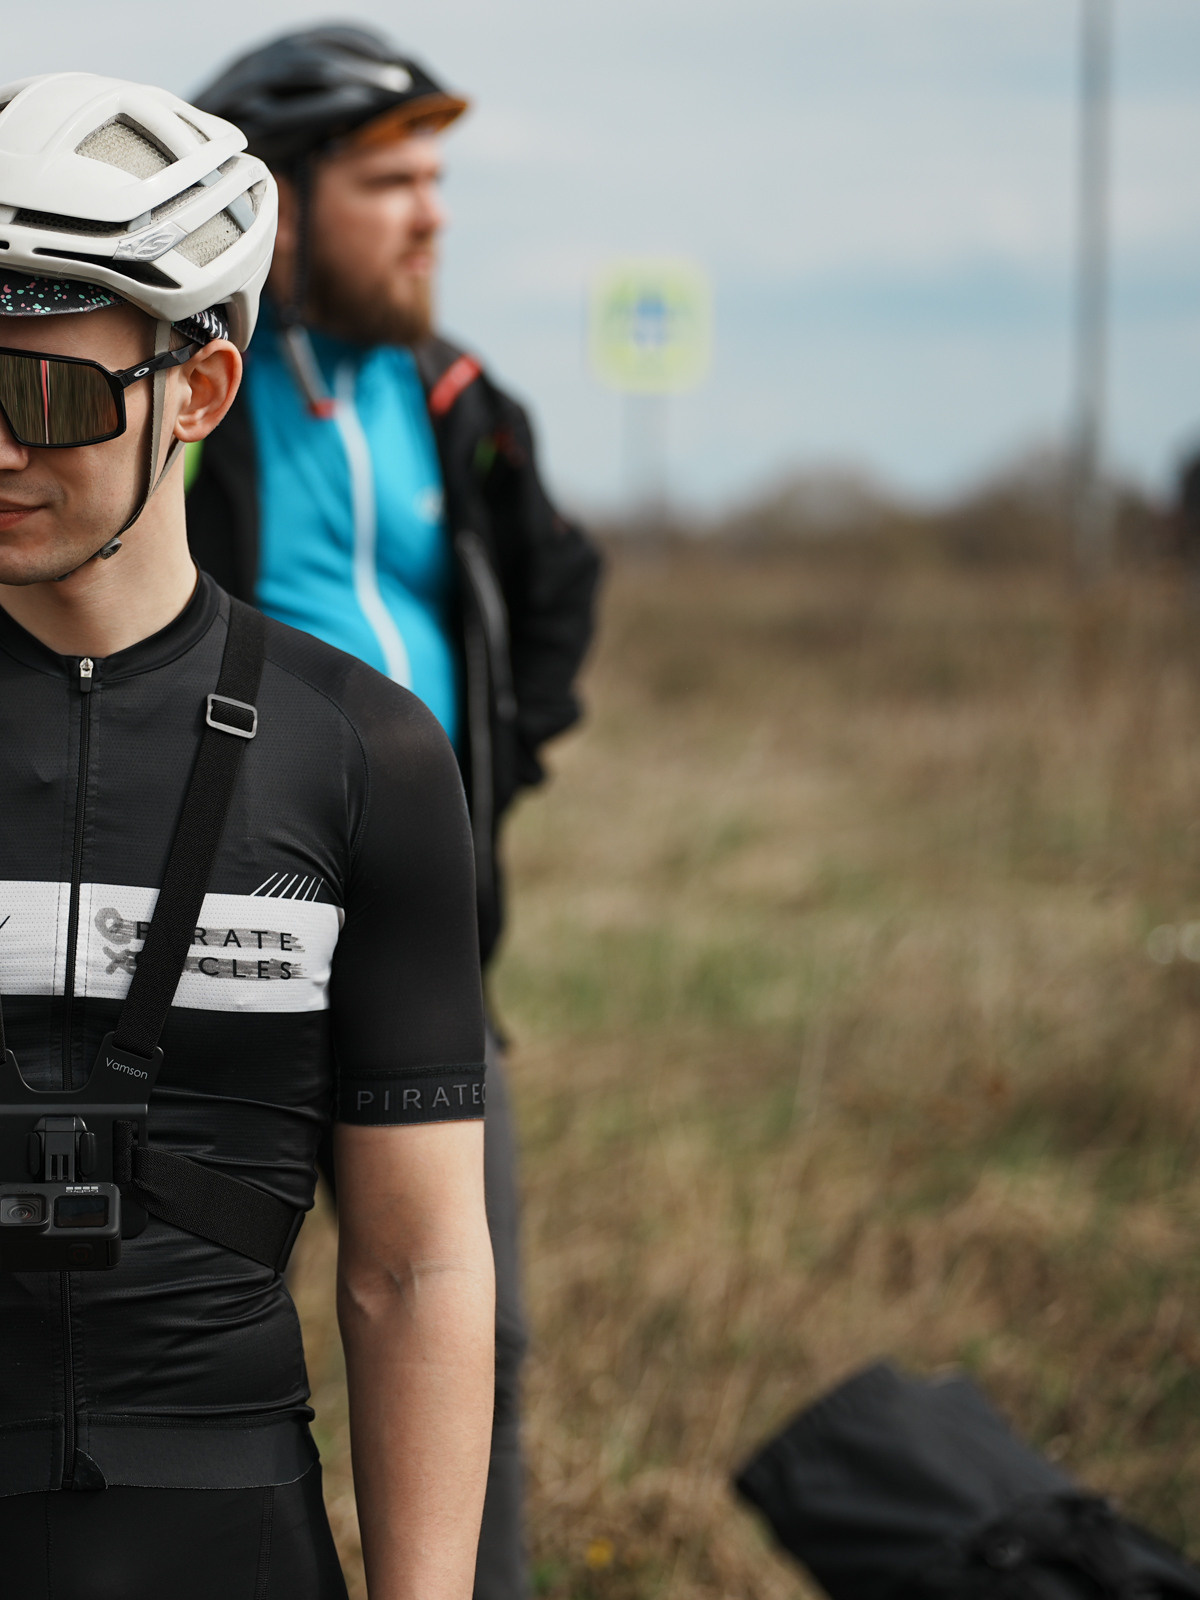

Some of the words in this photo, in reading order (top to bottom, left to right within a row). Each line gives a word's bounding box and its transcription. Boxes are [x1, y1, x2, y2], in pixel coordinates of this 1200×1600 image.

[135, 920, 293, 952] PRATE
[134, 952, 293, 980] CLES
[106, 1056, 148, 1080] Vamson
